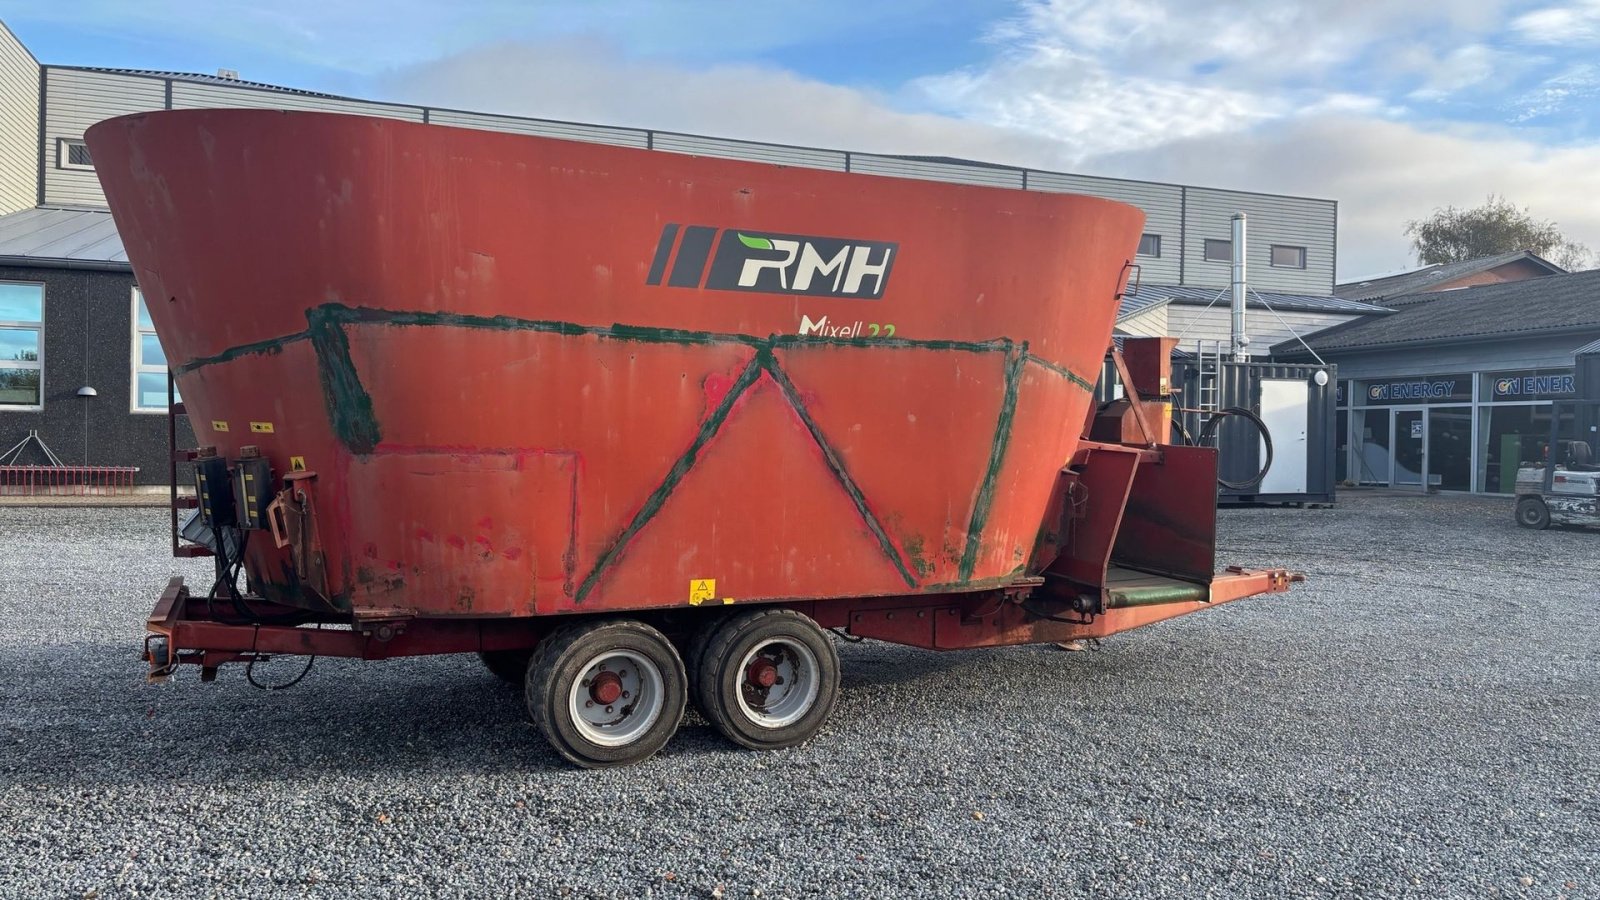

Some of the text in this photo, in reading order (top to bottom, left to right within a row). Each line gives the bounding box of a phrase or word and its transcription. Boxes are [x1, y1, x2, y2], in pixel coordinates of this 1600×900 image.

[738, 232, 891, 295] RMH
[799, 315, 896, 338] Mixell 22
[1391, 381, 1455, 399] ENERGY
